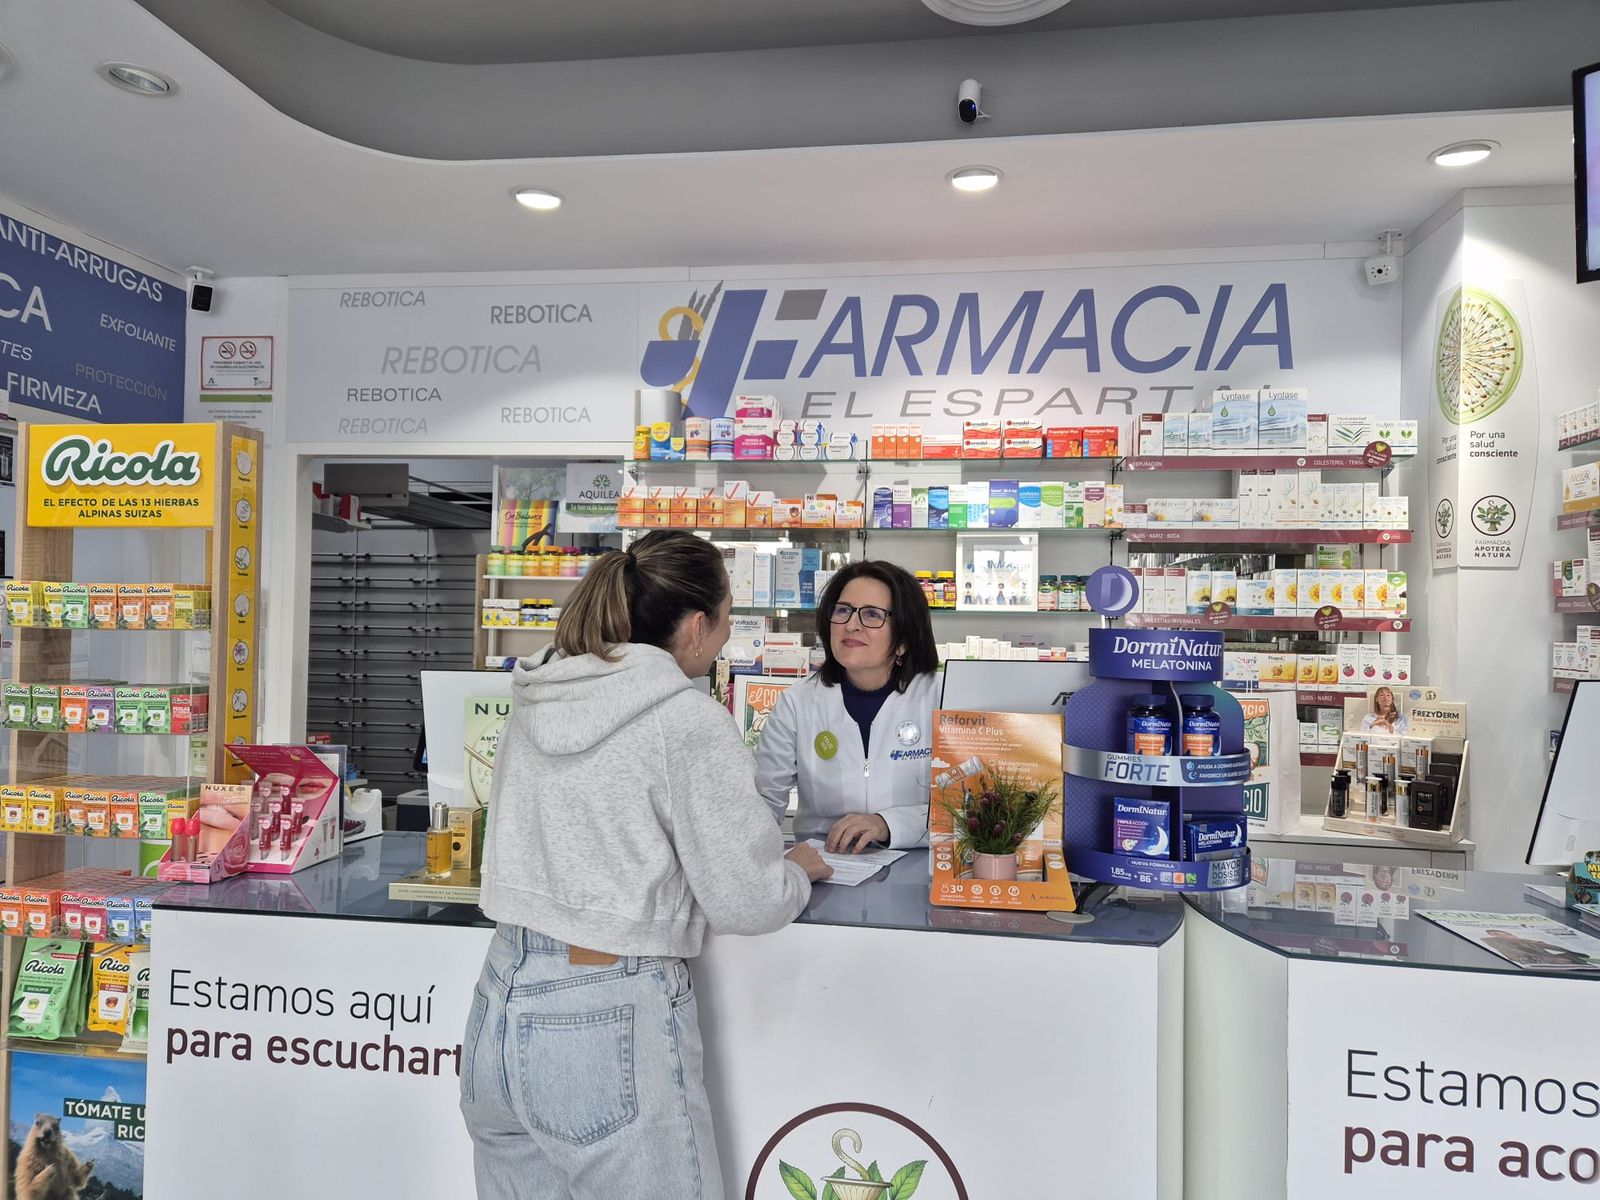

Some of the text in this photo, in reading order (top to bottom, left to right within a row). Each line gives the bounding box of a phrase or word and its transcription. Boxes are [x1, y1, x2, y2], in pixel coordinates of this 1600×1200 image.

[339, 290, 426, 308] REBOTICA
[490, 304, 593, 324] REBOTICA
[100, 313, 176, 352] EXFOLIANTE
[380, 345, 542, 374] REBOTICA
[75, 362, 168, 401] PROTECCIÓN
[7, 371, 103, 415] FIRMEZA
[346, 387, 442, 402] REBOTICA
[1221, 392, 1251, 400] Lynfase
[1269, 391, 1299, 400] Lynfase
[800, 384, 1271, 419] EL ESPART
[500, 406, 591, 423] REBOTICA
[337, 417, 428, 434] REBOTICA
[1470, 440, 1495, 448] salud
[1469, 449, 1518, 457] consciente
[45, 438, 197, 481] Ricola
[579, 490, 619, 500] AQUILEA
[44, 499, 199, 507] EL EFECTO DE LAS 13 HIERBAS
[78, 510, 162, 518] ALPINAS SUIZAS
[90, 585, 114, 594] Ricola
[119, 586, 143, 594] Ricola
[147, 585, 171, 594] Ricola
[1113, 636, 1222, 656] DormiNatur
[1131, 658, 1212, 671] MELATONINA
[475, 703, 509, 716] NU
[1412, 709, 1459, 719] FREZYDERM
[939, 715, 987, 727] Reforvit
[939, 726, 1004, 736] Vitamina C Plus
[1106, 754, 1142, 763] GUMMIES
[1104, 761, 1170, 782] FORTE
[2, 789, 24, 797] Ricola
[29, 790, 52, 799] Ricola
[83, 794, 107, 802] Ricola
[112, 795, 135, 803] Ricola
[1117, 804, 1167, 815] DormiNatur
[1198, 830, 1236, 842] DormiNatur
[1212, 861, 1240, 870] MAYOR
[1140, 875, 1151, 883] B6
[950, 884, 963, 893] 30
[25, 895, 48, 903] Ricola
[25, 960, 64, 975] Ricola
[100, 958, 130, 972] Rico
[170, 969, 435, 1031] Estamos aquí
[166, 1028, 462, 1077] para escuchart
[1347, 1049, 1600, 1118] Estamos
[65, 1100, 131, 1121] TÓMATE
[117, 1124, 144, 1139] RIC
[1344, 1126, 1474, 1174] para
